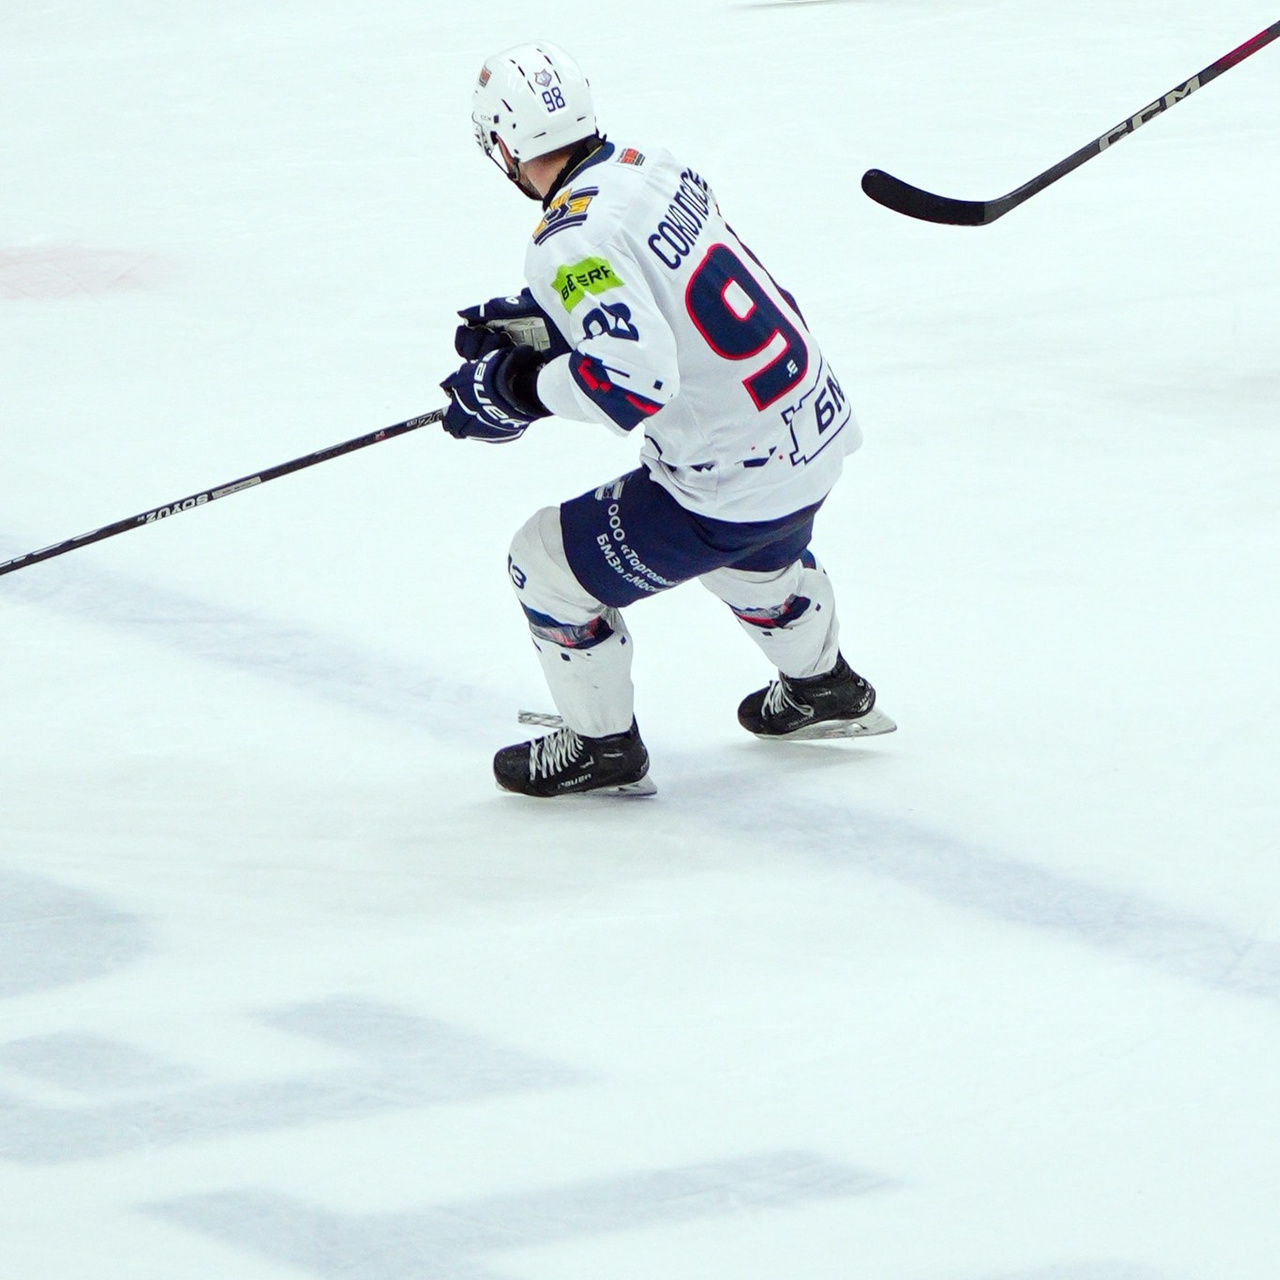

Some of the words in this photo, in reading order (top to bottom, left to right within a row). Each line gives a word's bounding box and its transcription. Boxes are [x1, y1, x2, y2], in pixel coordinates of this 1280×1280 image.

[541, 85, 566, 113] 98
[685, 242, 809, 412] 9
[145, 493, 209, 524] SOYUZ
[608, 503, 626, 542] ООО
[596, 533, 625, 575] БМЗ»
